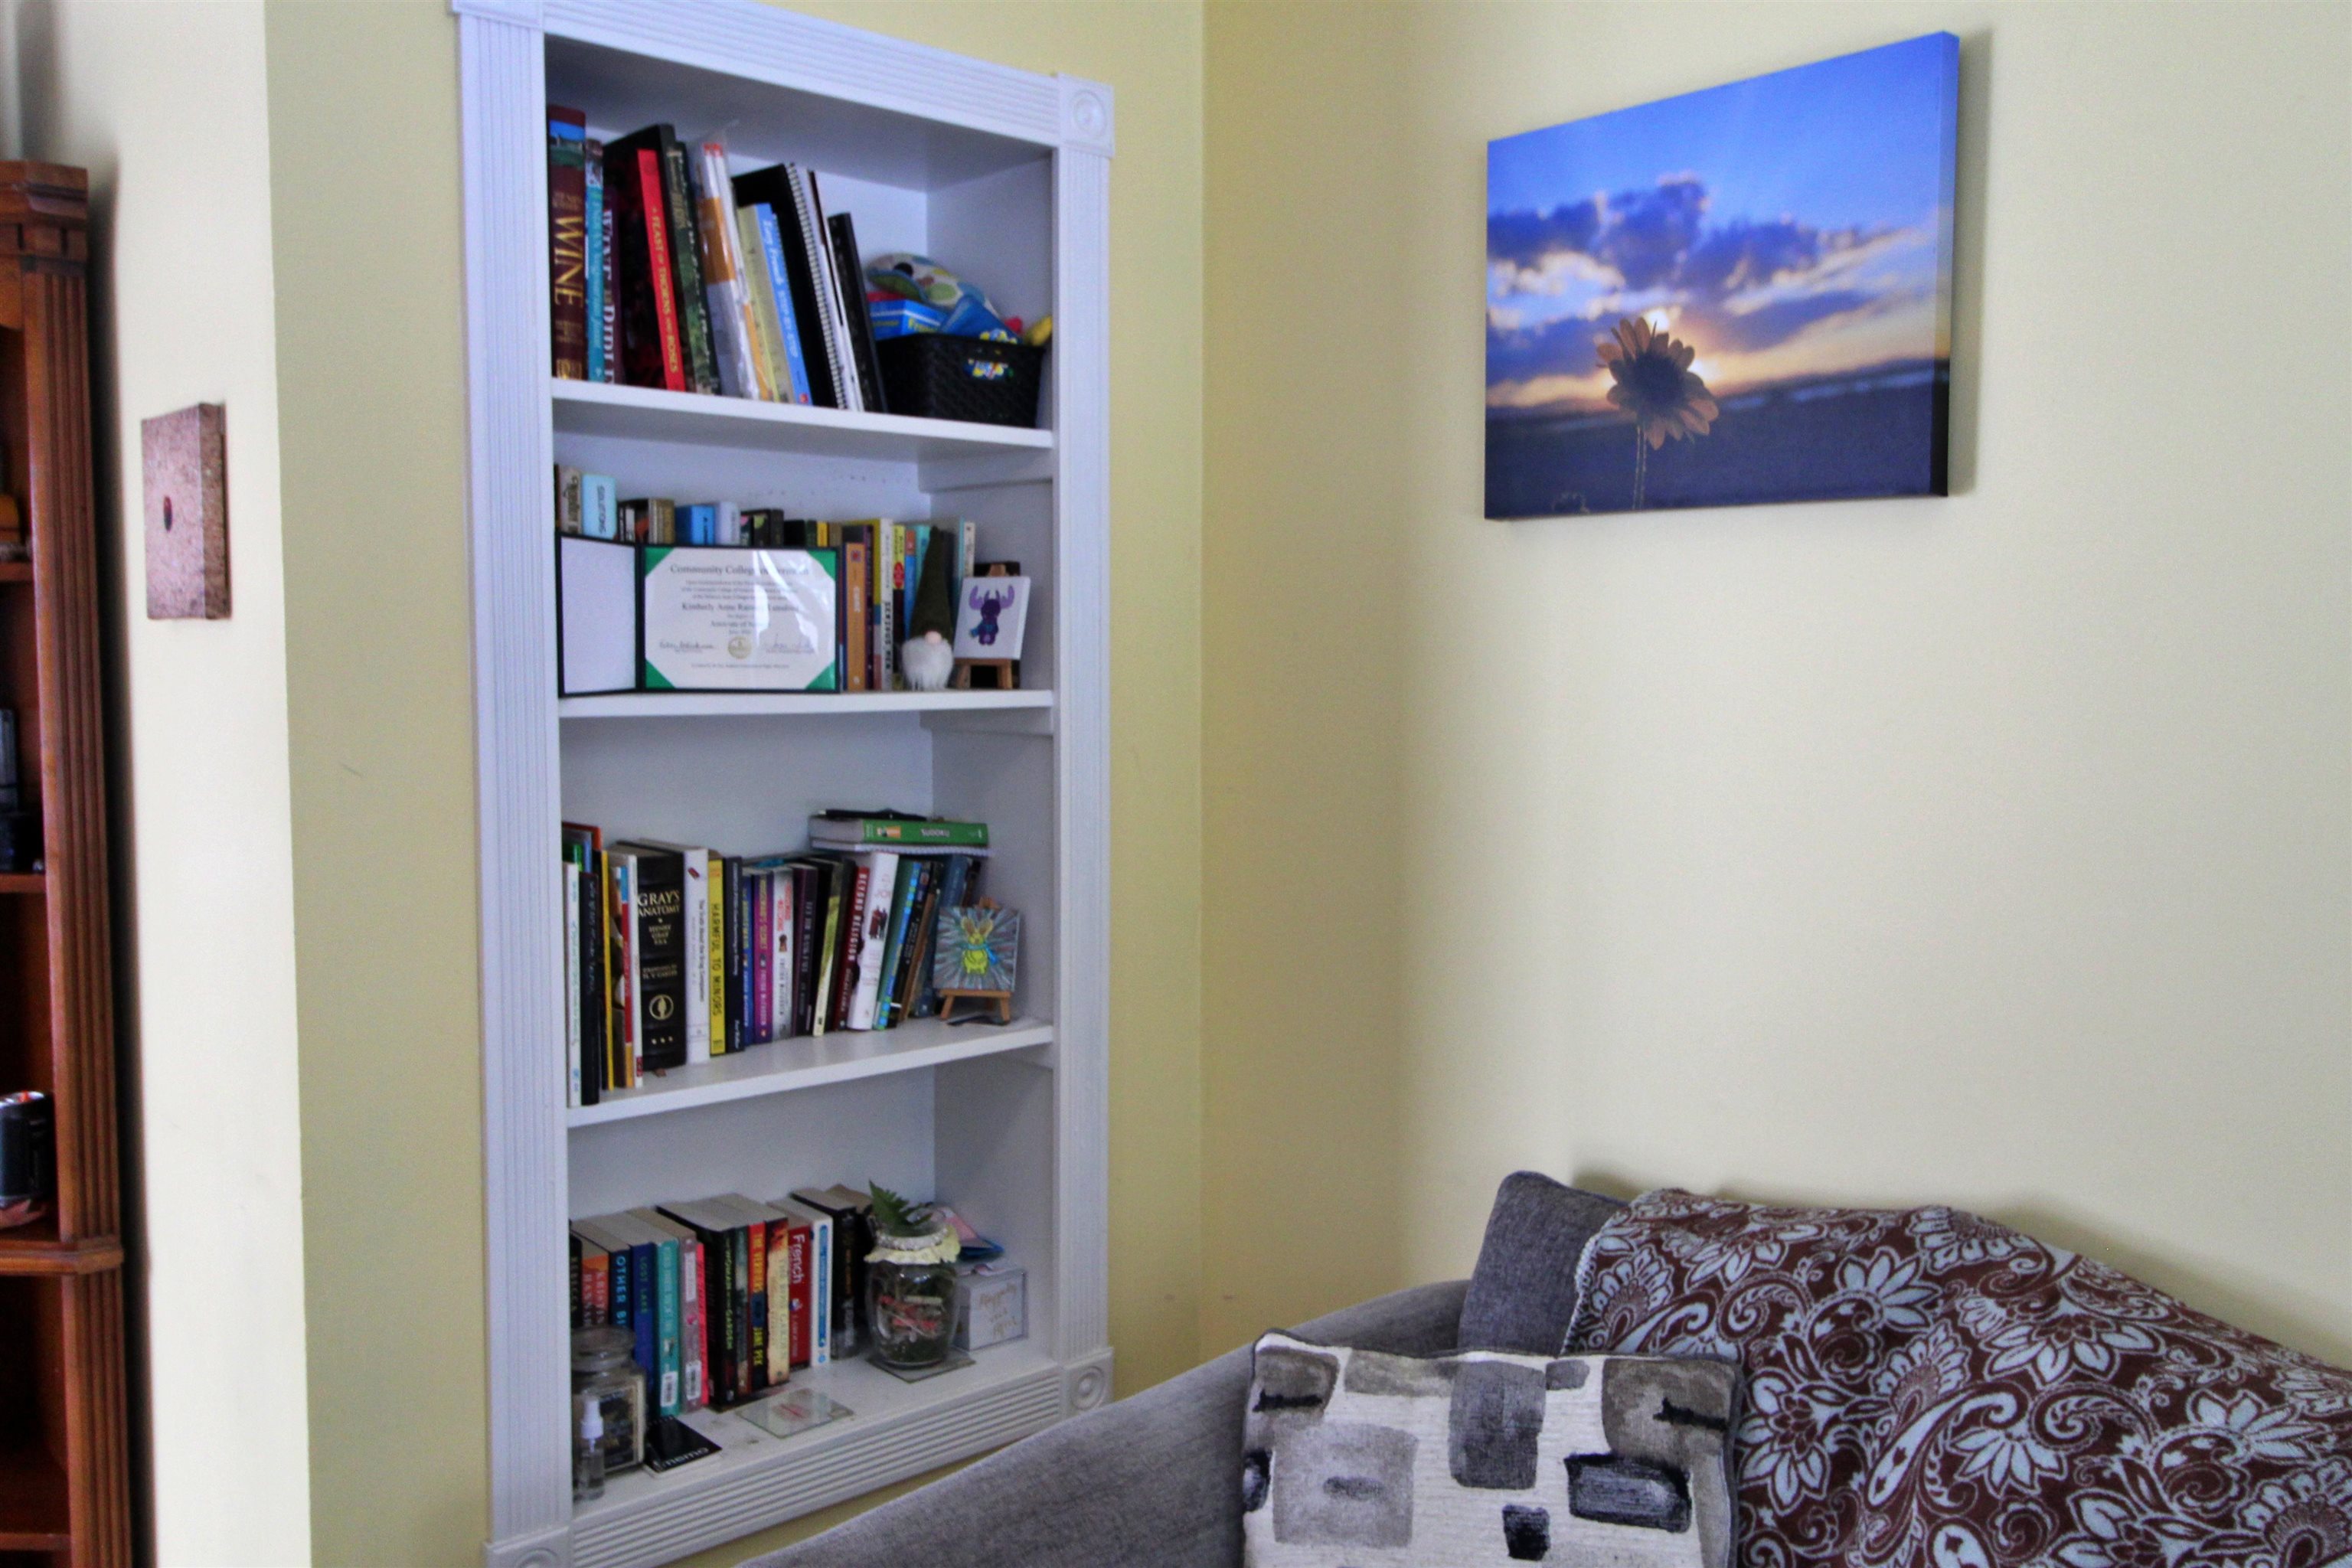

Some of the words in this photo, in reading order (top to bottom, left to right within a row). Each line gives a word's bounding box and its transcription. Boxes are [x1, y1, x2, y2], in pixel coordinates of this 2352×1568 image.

[554, 215, 584, 307] WINE
[665, 333, 679, 373] ROSES
[670, 564, 723, 576] Community
[637, 889, 681, 906] GRAY'S
[638, 905, 680, 918] ANATOMY
[854, 873, 868, 913] BEYOND
[710, 903, 722, 952] HARMFUL
[847, 914, 864, 962] RELIGION
[711, 958, 722, 970] TO
[711, 975, 723, 1017] MINORS
[753, 1233, 765, 1251] THE
[792, 1233, 805, 1285] French
[616, 1255, 626, 1304] OTHER
[639, 1256, 648, 1282] LOST
[724, 1250, 733, 1290] WOMAN
[595, 1270, 606, 1324] KRISTIN
[724, 1308, 734, 1350] GARDEN
